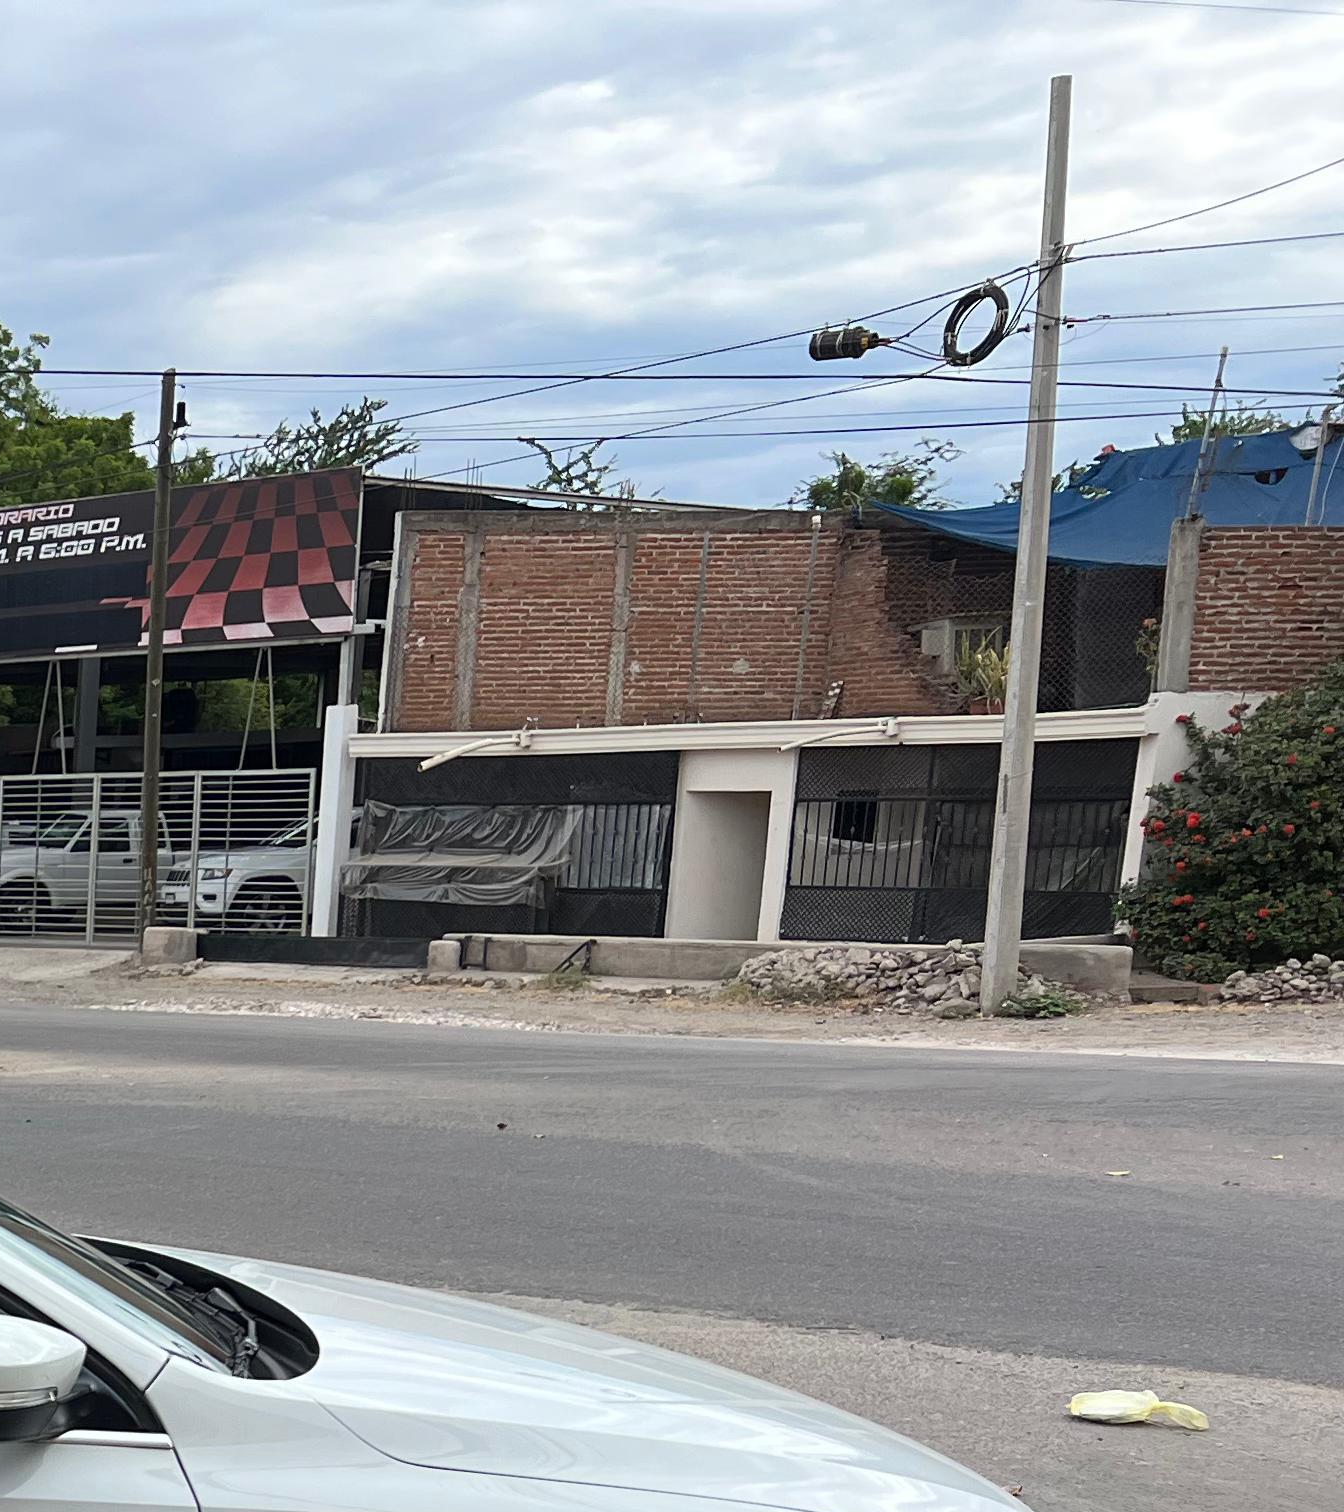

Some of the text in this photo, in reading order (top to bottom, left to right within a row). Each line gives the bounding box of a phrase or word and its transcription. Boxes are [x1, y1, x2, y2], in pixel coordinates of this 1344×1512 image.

[7, 528, 25, 544] A
[27, 517, 121, 541] SABADO
[15, 545, 35, 562] A
[38, 538, 96, 560] 6:00
[99, 533, 147, 553] P.M.
